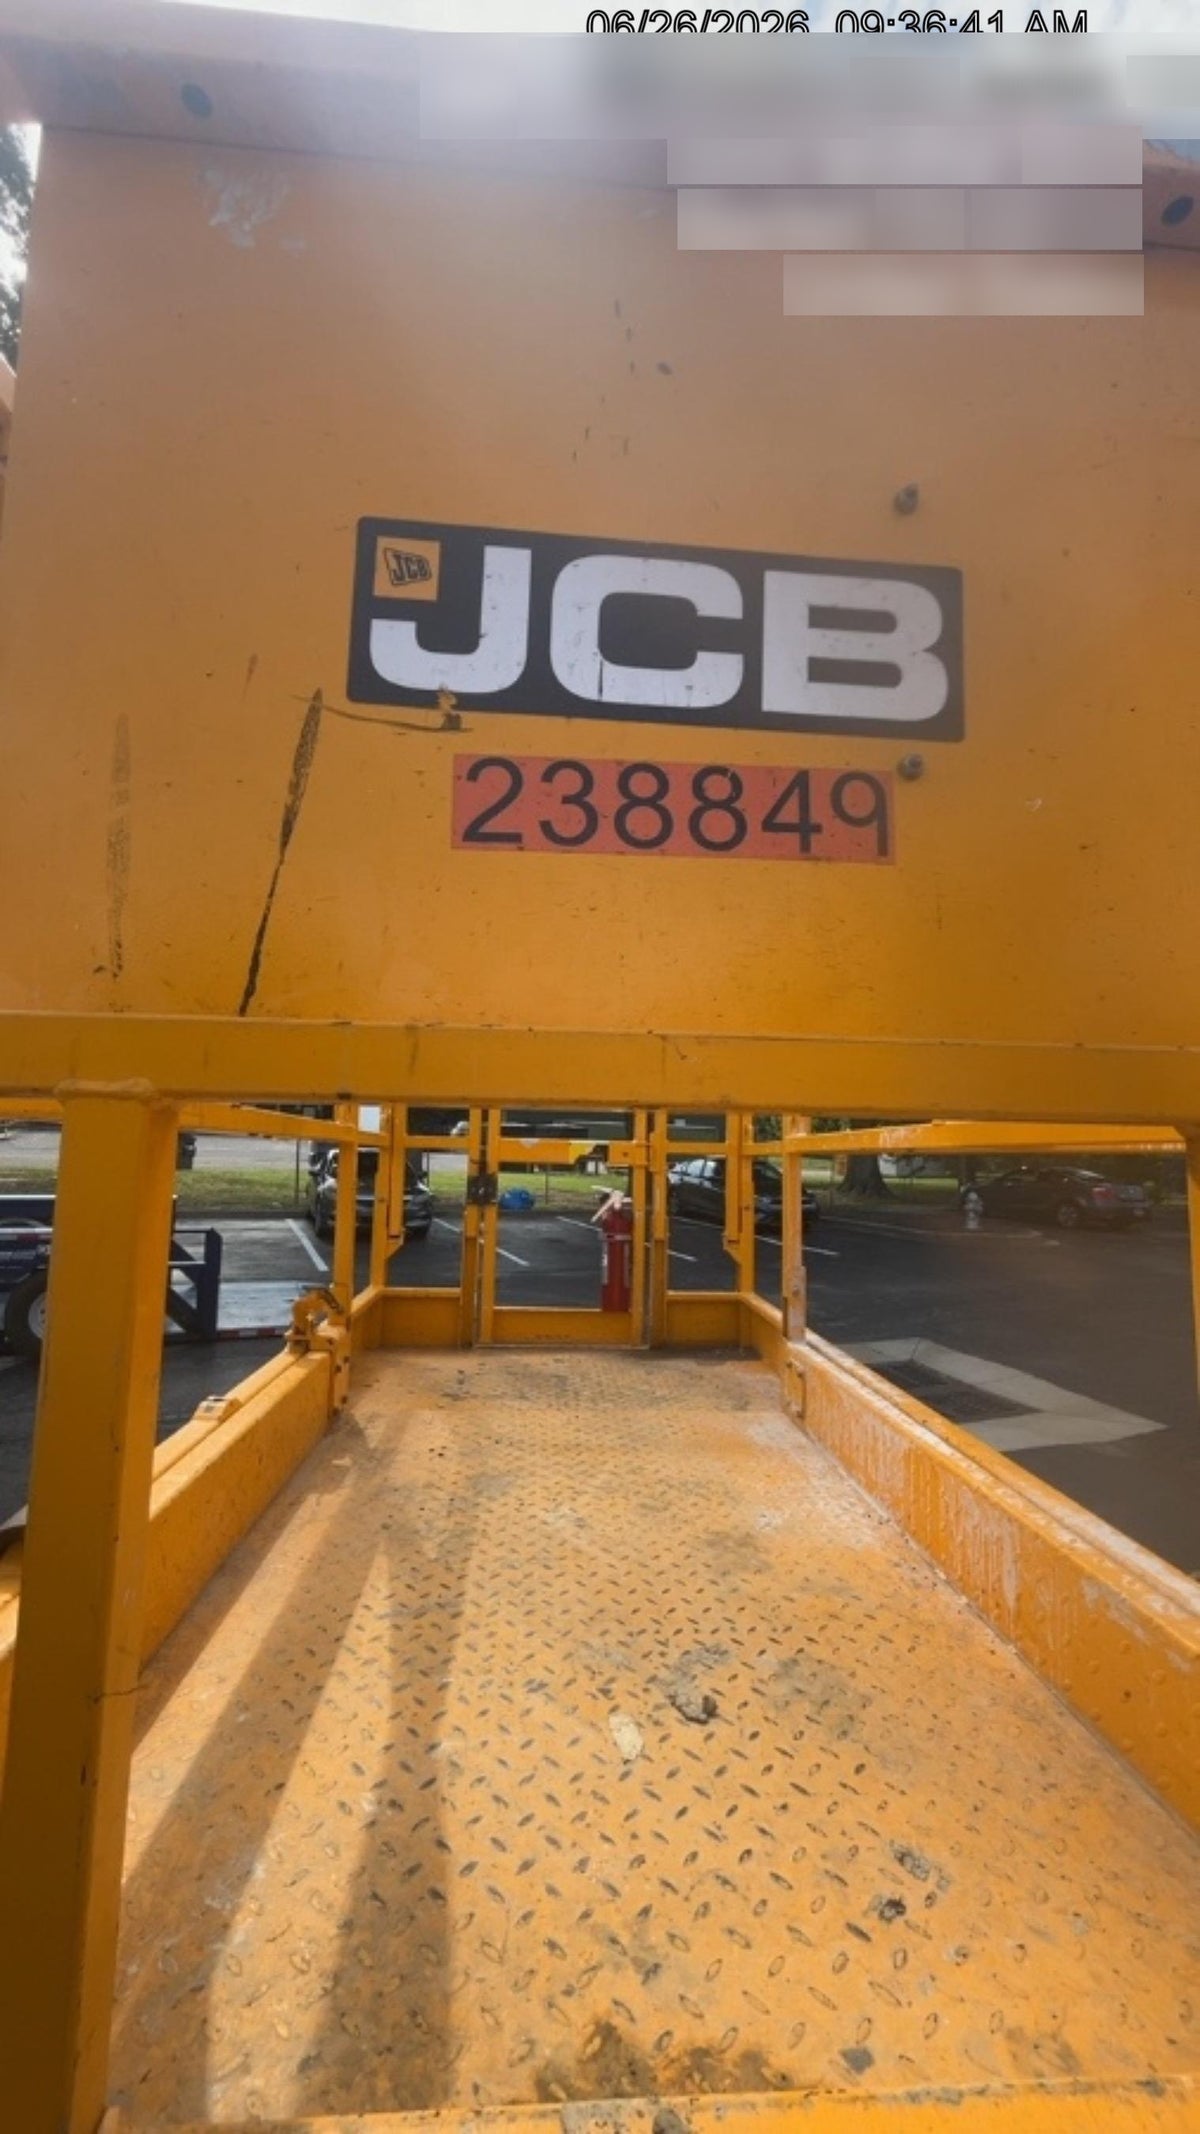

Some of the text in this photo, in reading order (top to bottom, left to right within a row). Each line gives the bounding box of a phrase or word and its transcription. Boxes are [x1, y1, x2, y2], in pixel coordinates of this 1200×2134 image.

[387, 551, 431, 583] JCB
[369, 545, 949, 722] JCB
[462, 756, 889, 857] 238849
